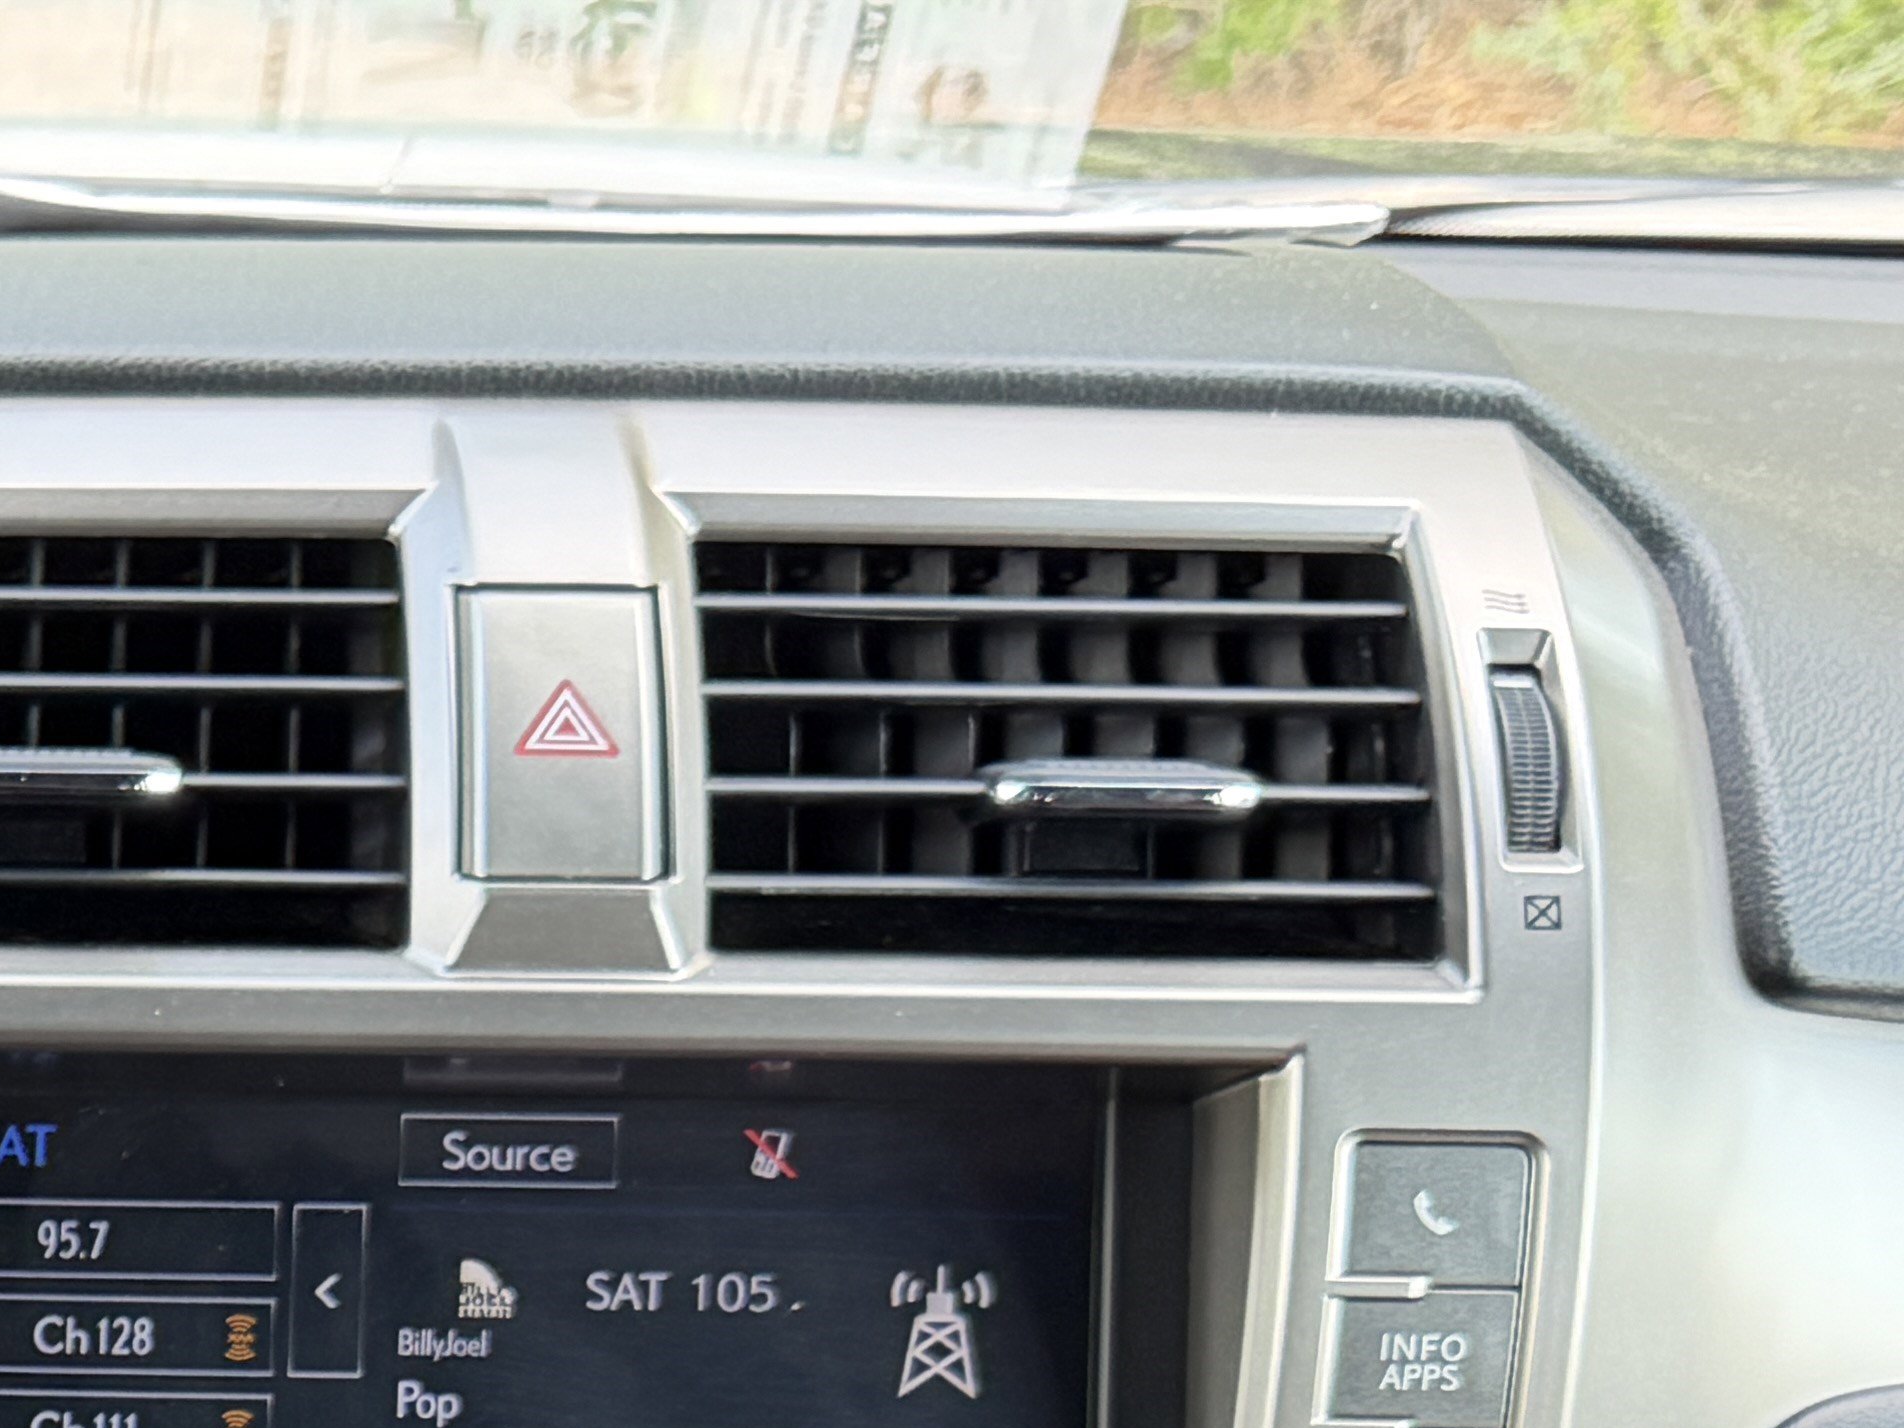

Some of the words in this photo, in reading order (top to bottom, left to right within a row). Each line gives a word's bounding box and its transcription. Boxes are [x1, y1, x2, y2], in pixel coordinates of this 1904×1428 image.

[442, 1130, 578, 1173] Source
[37, 1220, 110, 1260] 95.7
[585, 1271, 671, 1312] SAT
[692, 1272, 778, 1313] 105
[1380, 1332, 1468, 1362] INFO
[1378, 1364, 1464, 1392] APPS
[396, 1379, 463, 1428] Pop
